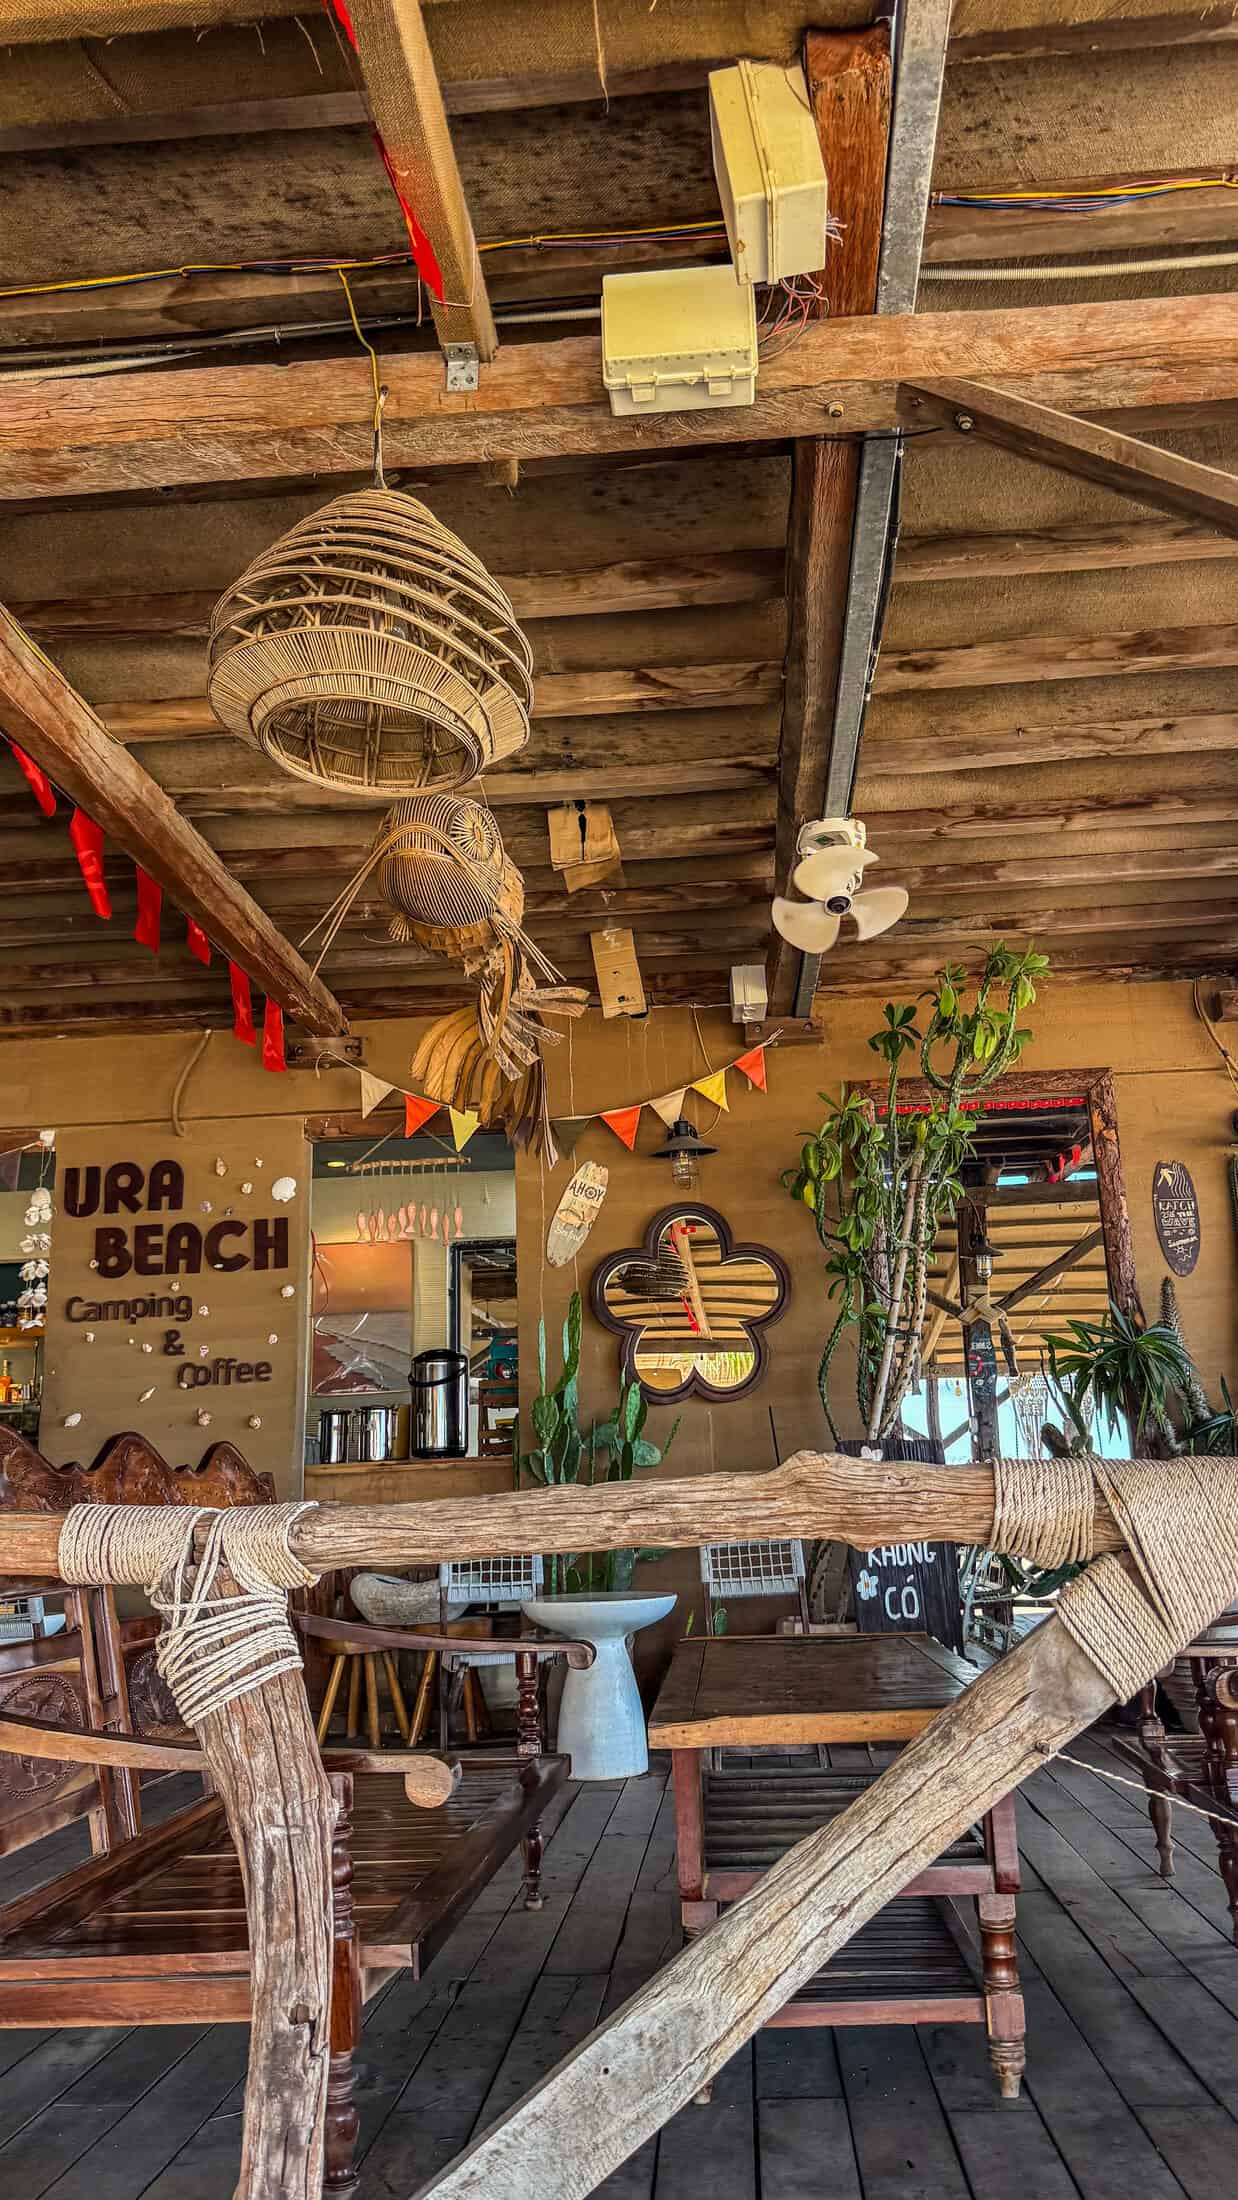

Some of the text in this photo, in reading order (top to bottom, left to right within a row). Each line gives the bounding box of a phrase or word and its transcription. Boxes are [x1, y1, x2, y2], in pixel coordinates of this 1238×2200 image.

[64, 1160, 185, 1217] URA
[568, 1179, 604, 1202] AHOY
[94, 1217, 289, 1279] BEACH
[65, 1293, 193, 1324] Camping
[163, 1329, 185, 1356] &
[177, 1357, 273, 1390] Coffee
[884, 1573, 920, 1621] CÓ
